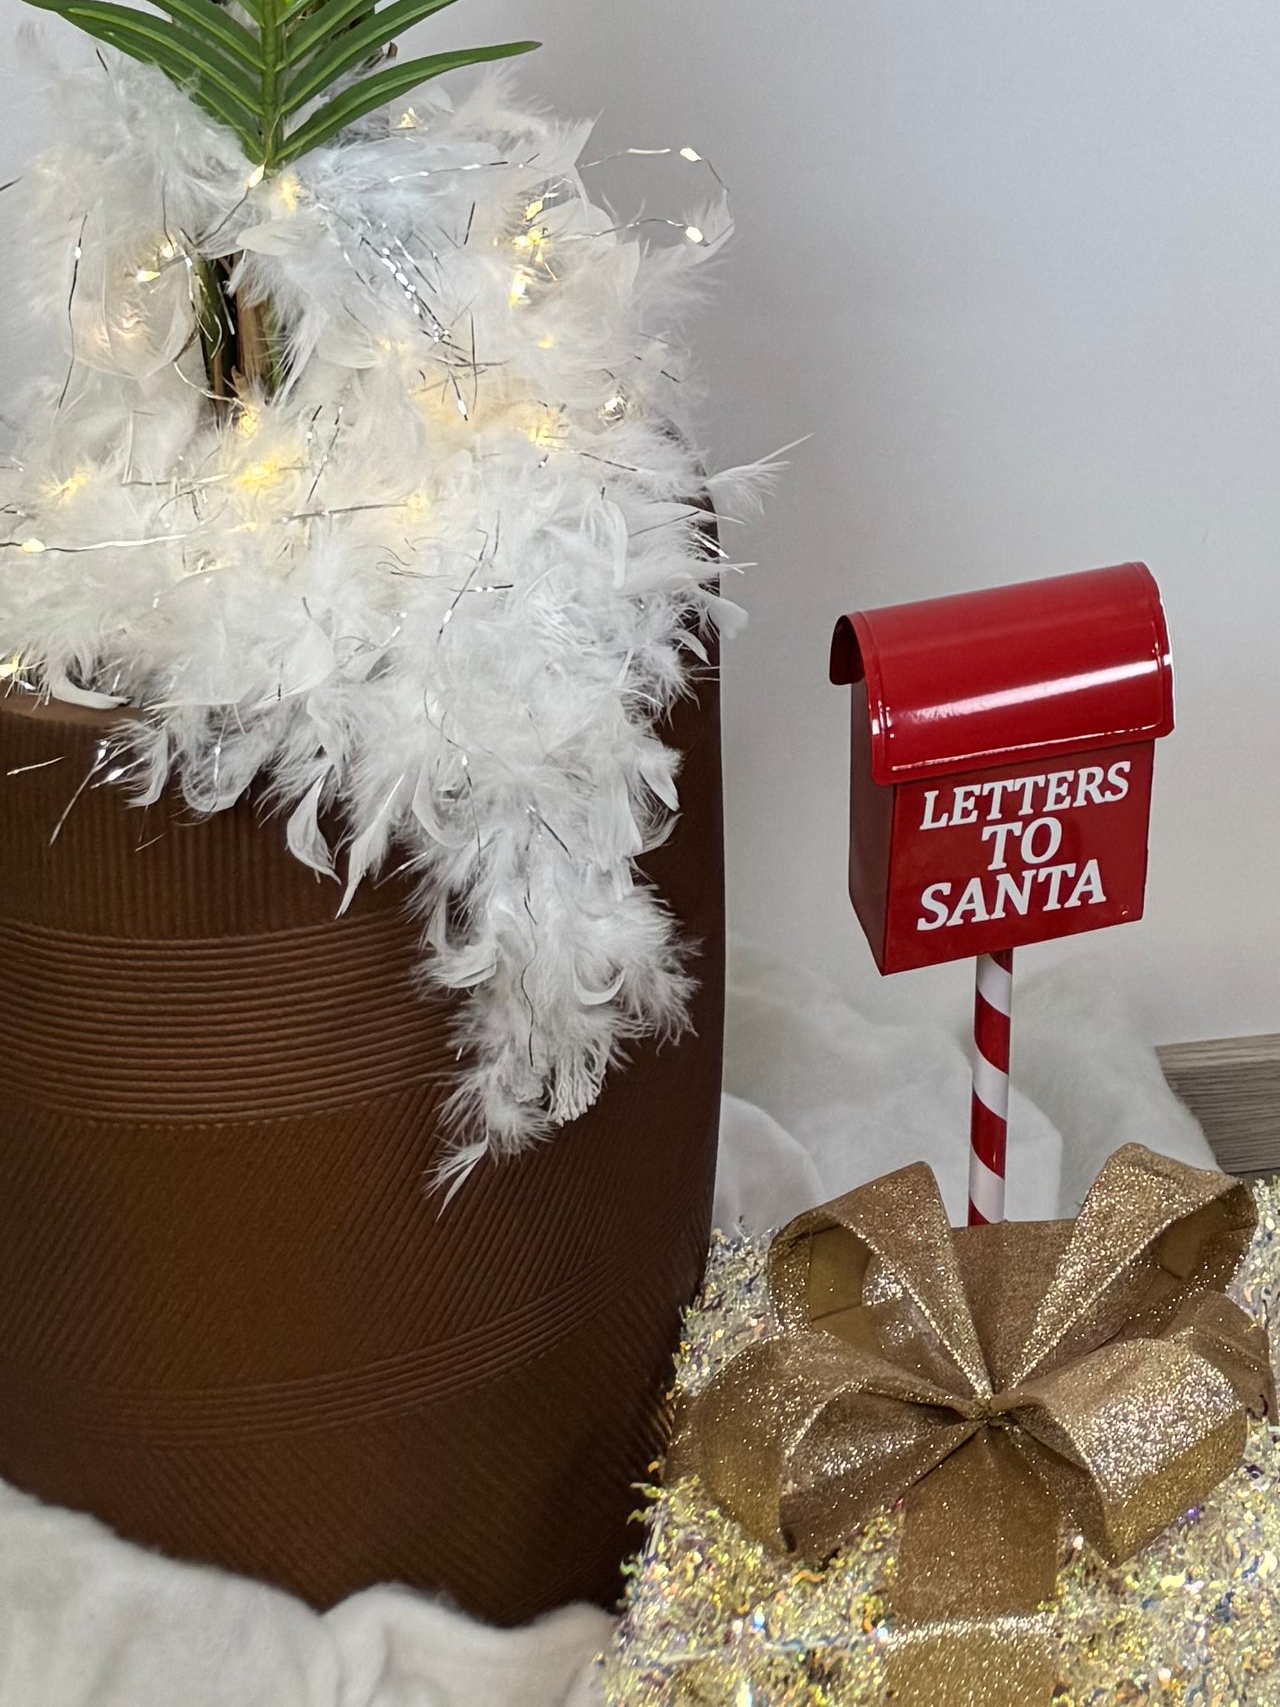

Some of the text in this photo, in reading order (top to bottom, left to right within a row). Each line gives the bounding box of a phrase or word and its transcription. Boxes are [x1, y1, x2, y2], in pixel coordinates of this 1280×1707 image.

[919, 761, 1131, 830] LETTERS
[981, 817, 1062, 871] TO
[916, 859, 1107, 931] SANTA
